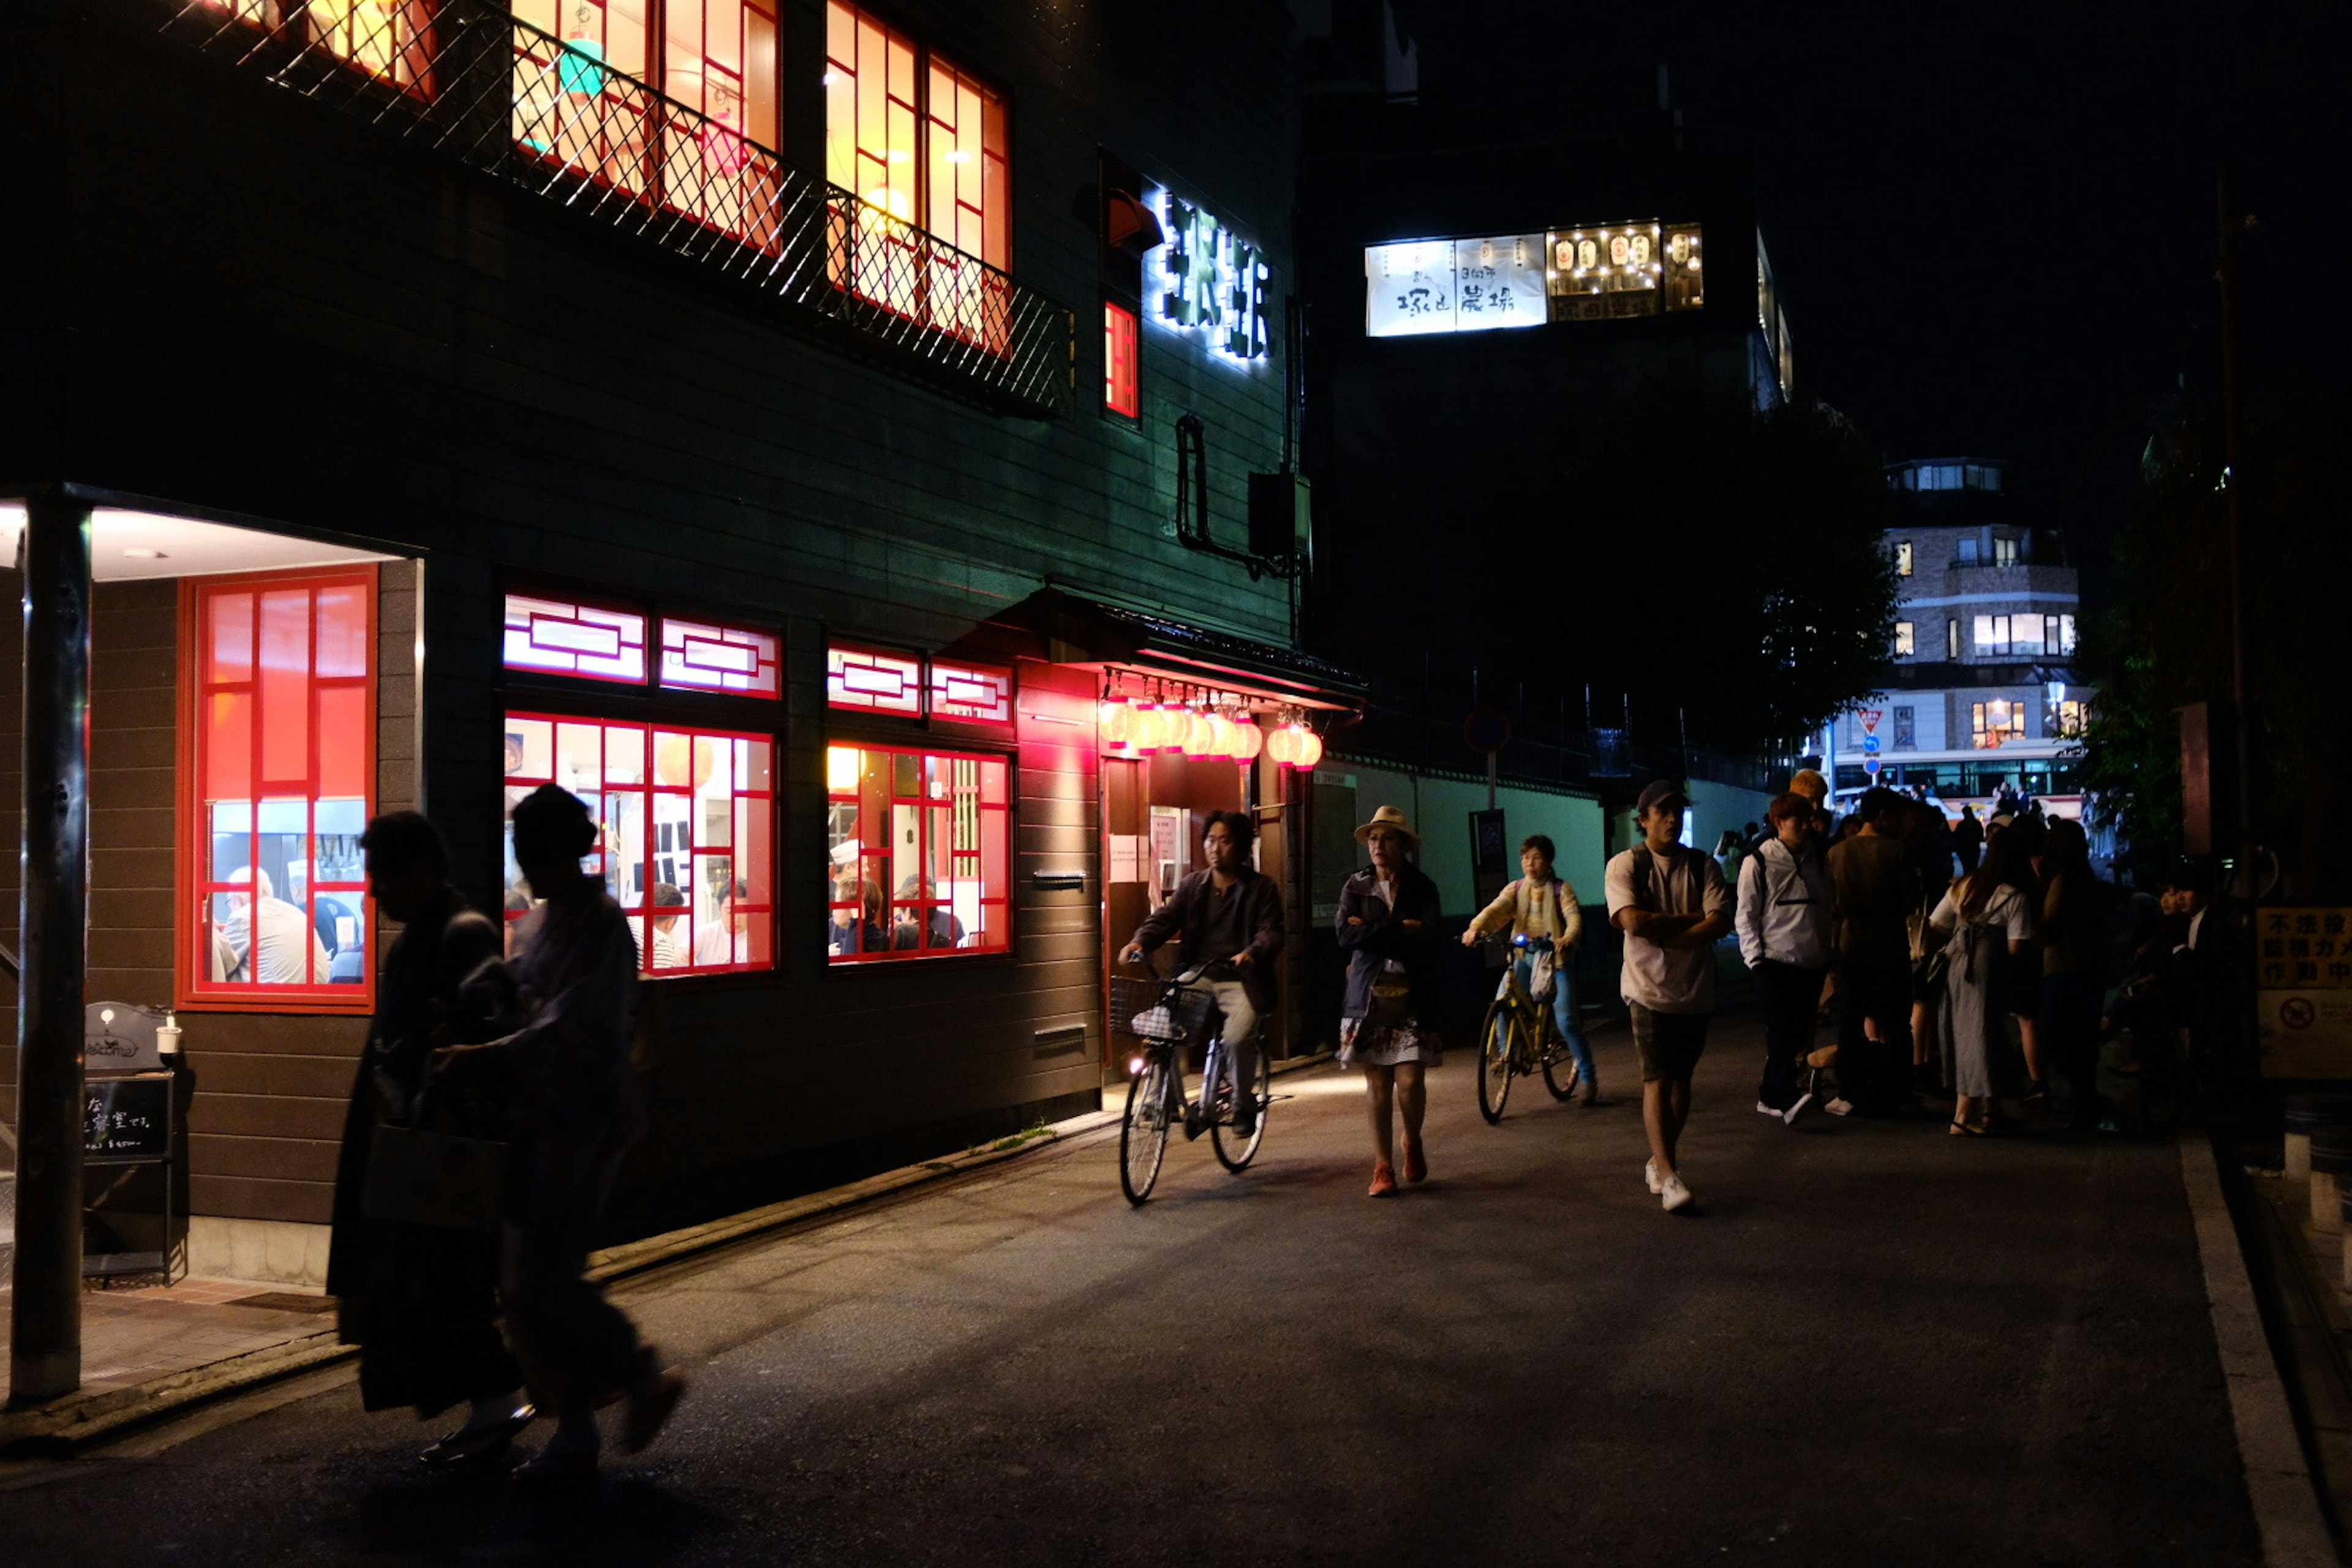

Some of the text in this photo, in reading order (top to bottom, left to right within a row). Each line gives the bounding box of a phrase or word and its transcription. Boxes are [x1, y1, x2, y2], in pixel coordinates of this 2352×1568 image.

[2269, 913, 2346, 934] 不法投
[2266, 961, 2351, 981] 作動中
[85, 1042, 137, 1058] elcome
